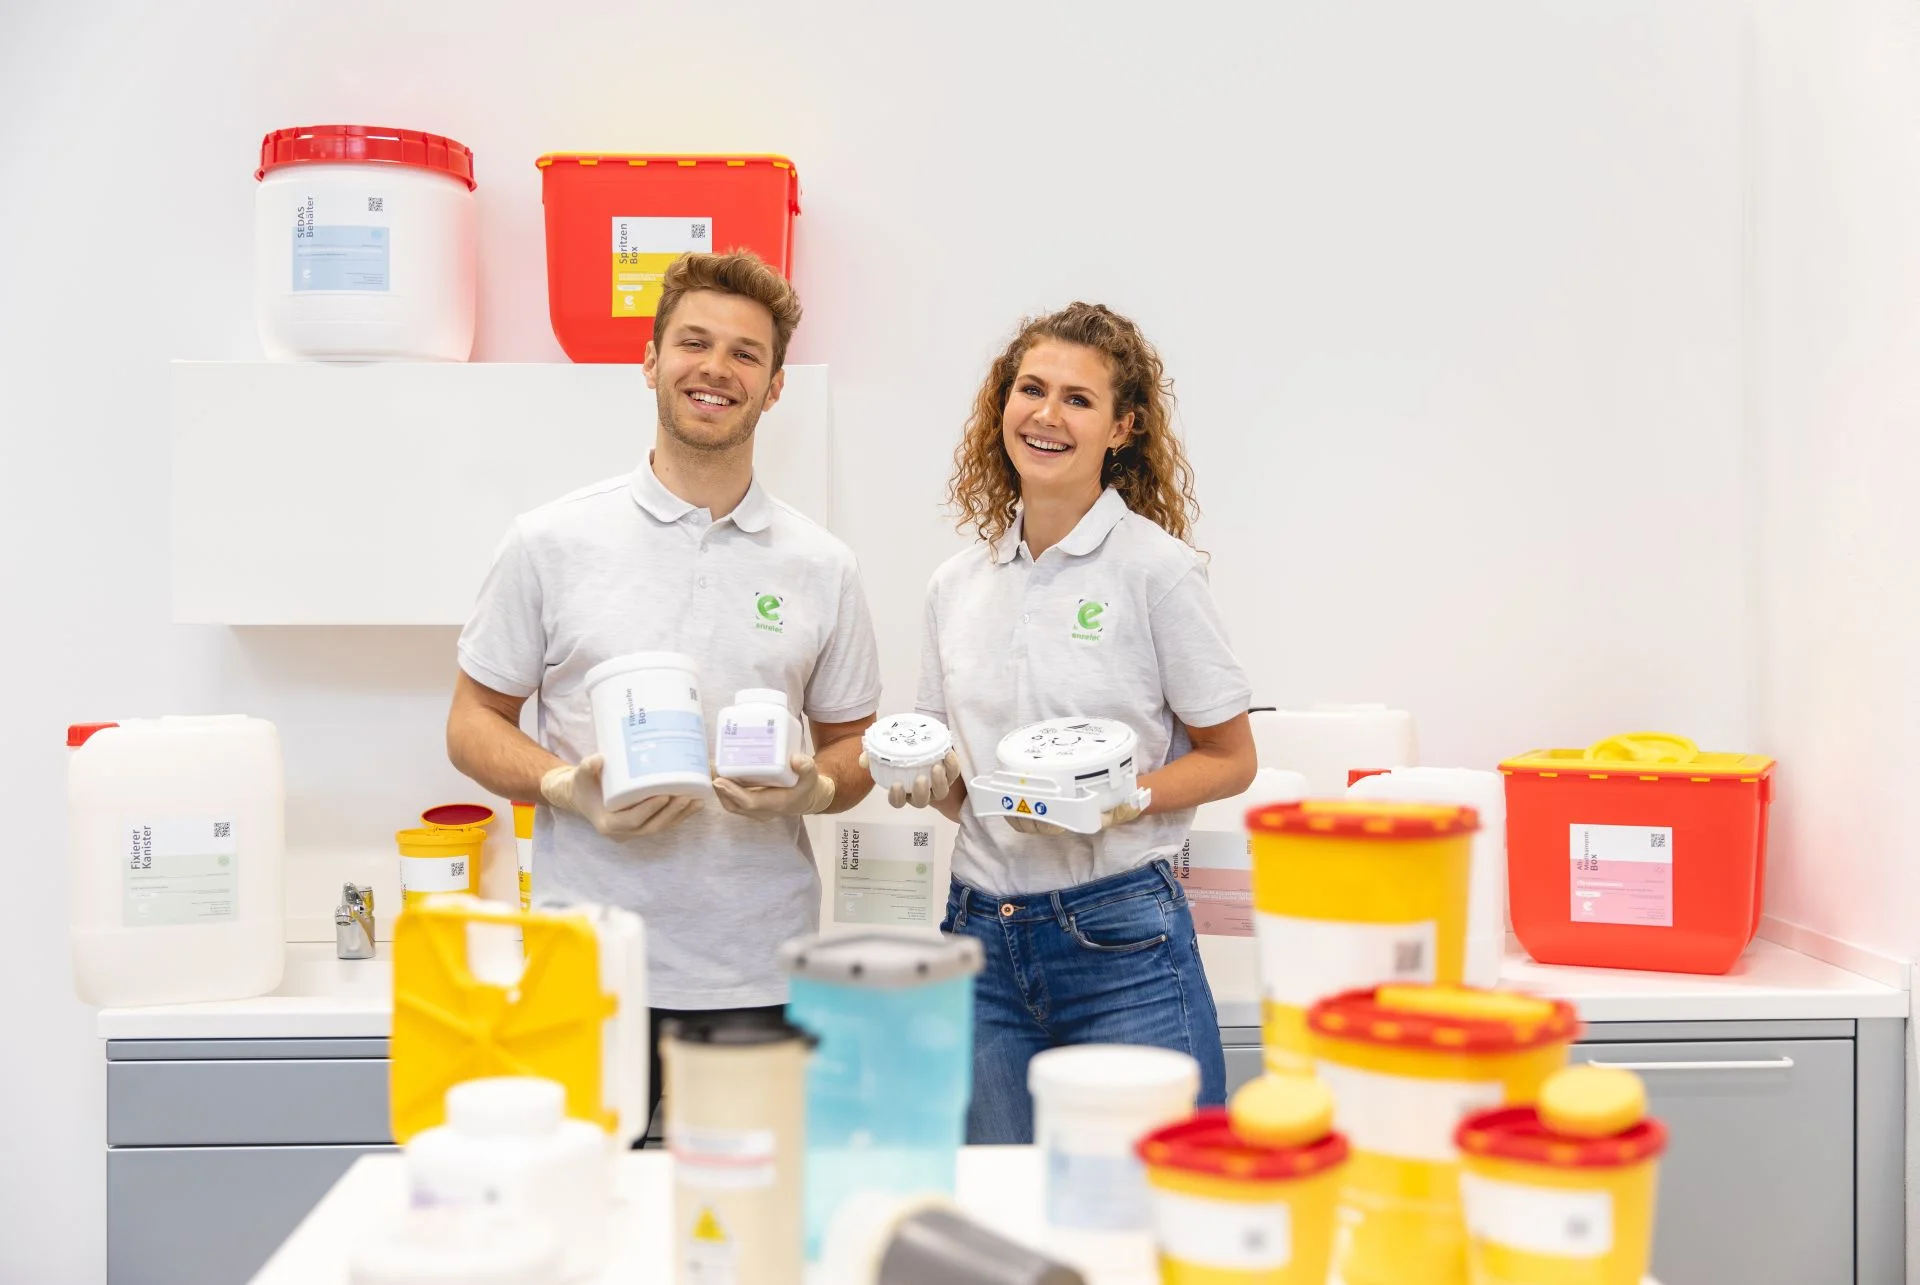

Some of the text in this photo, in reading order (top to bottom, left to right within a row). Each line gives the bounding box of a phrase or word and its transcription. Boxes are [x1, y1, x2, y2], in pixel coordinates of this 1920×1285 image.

[297, 206, 305, 239] SEDAS
[306, 196, 314, 238] Behälter
[619, 223, 629, 265] Spritzen
[630, 246, 638, 264] Box
[638, 708, 647, 725] Box
[130, 829, 140, 870] Fixierer
[142, 825, 151, 869] Kanister
[841, 828, 849, 870] Entwickler
[850, 829, 860, 871] Kanister
[1590, 854, 1599, 871] Box
